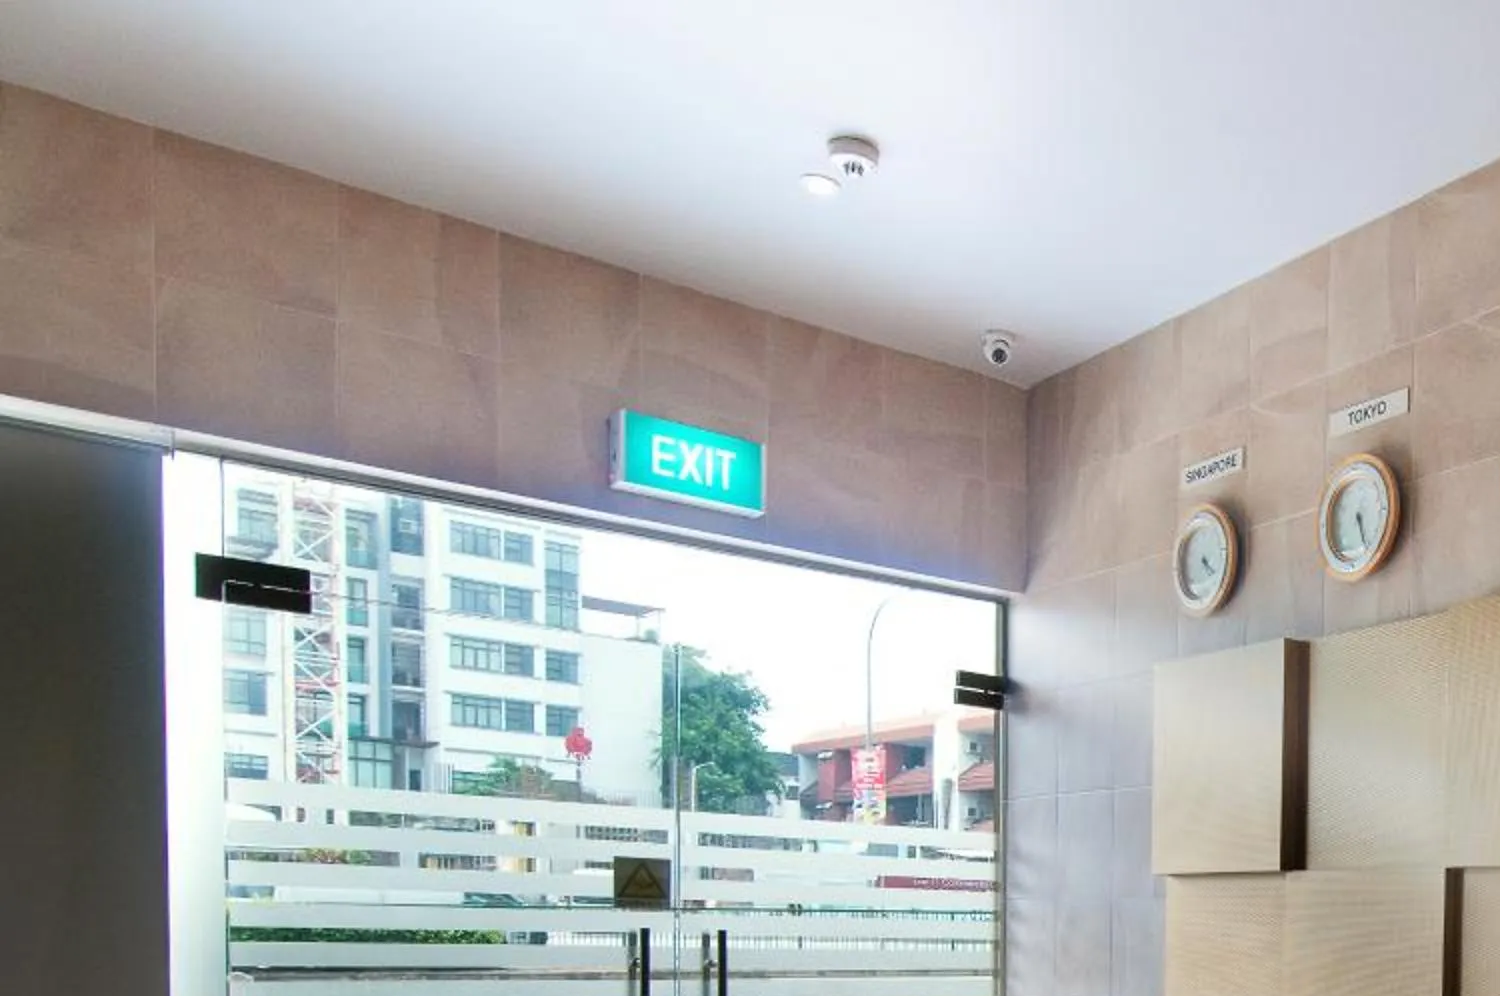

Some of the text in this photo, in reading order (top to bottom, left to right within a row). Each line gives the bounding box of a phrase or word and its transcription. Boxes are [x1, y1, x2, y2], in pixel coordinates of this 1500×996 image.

[1347, 401, 1387, 425] TOKYO
[651, 435, 737, 491] EXIT
[1185, 454, 1237, 483] SINGAPORE
